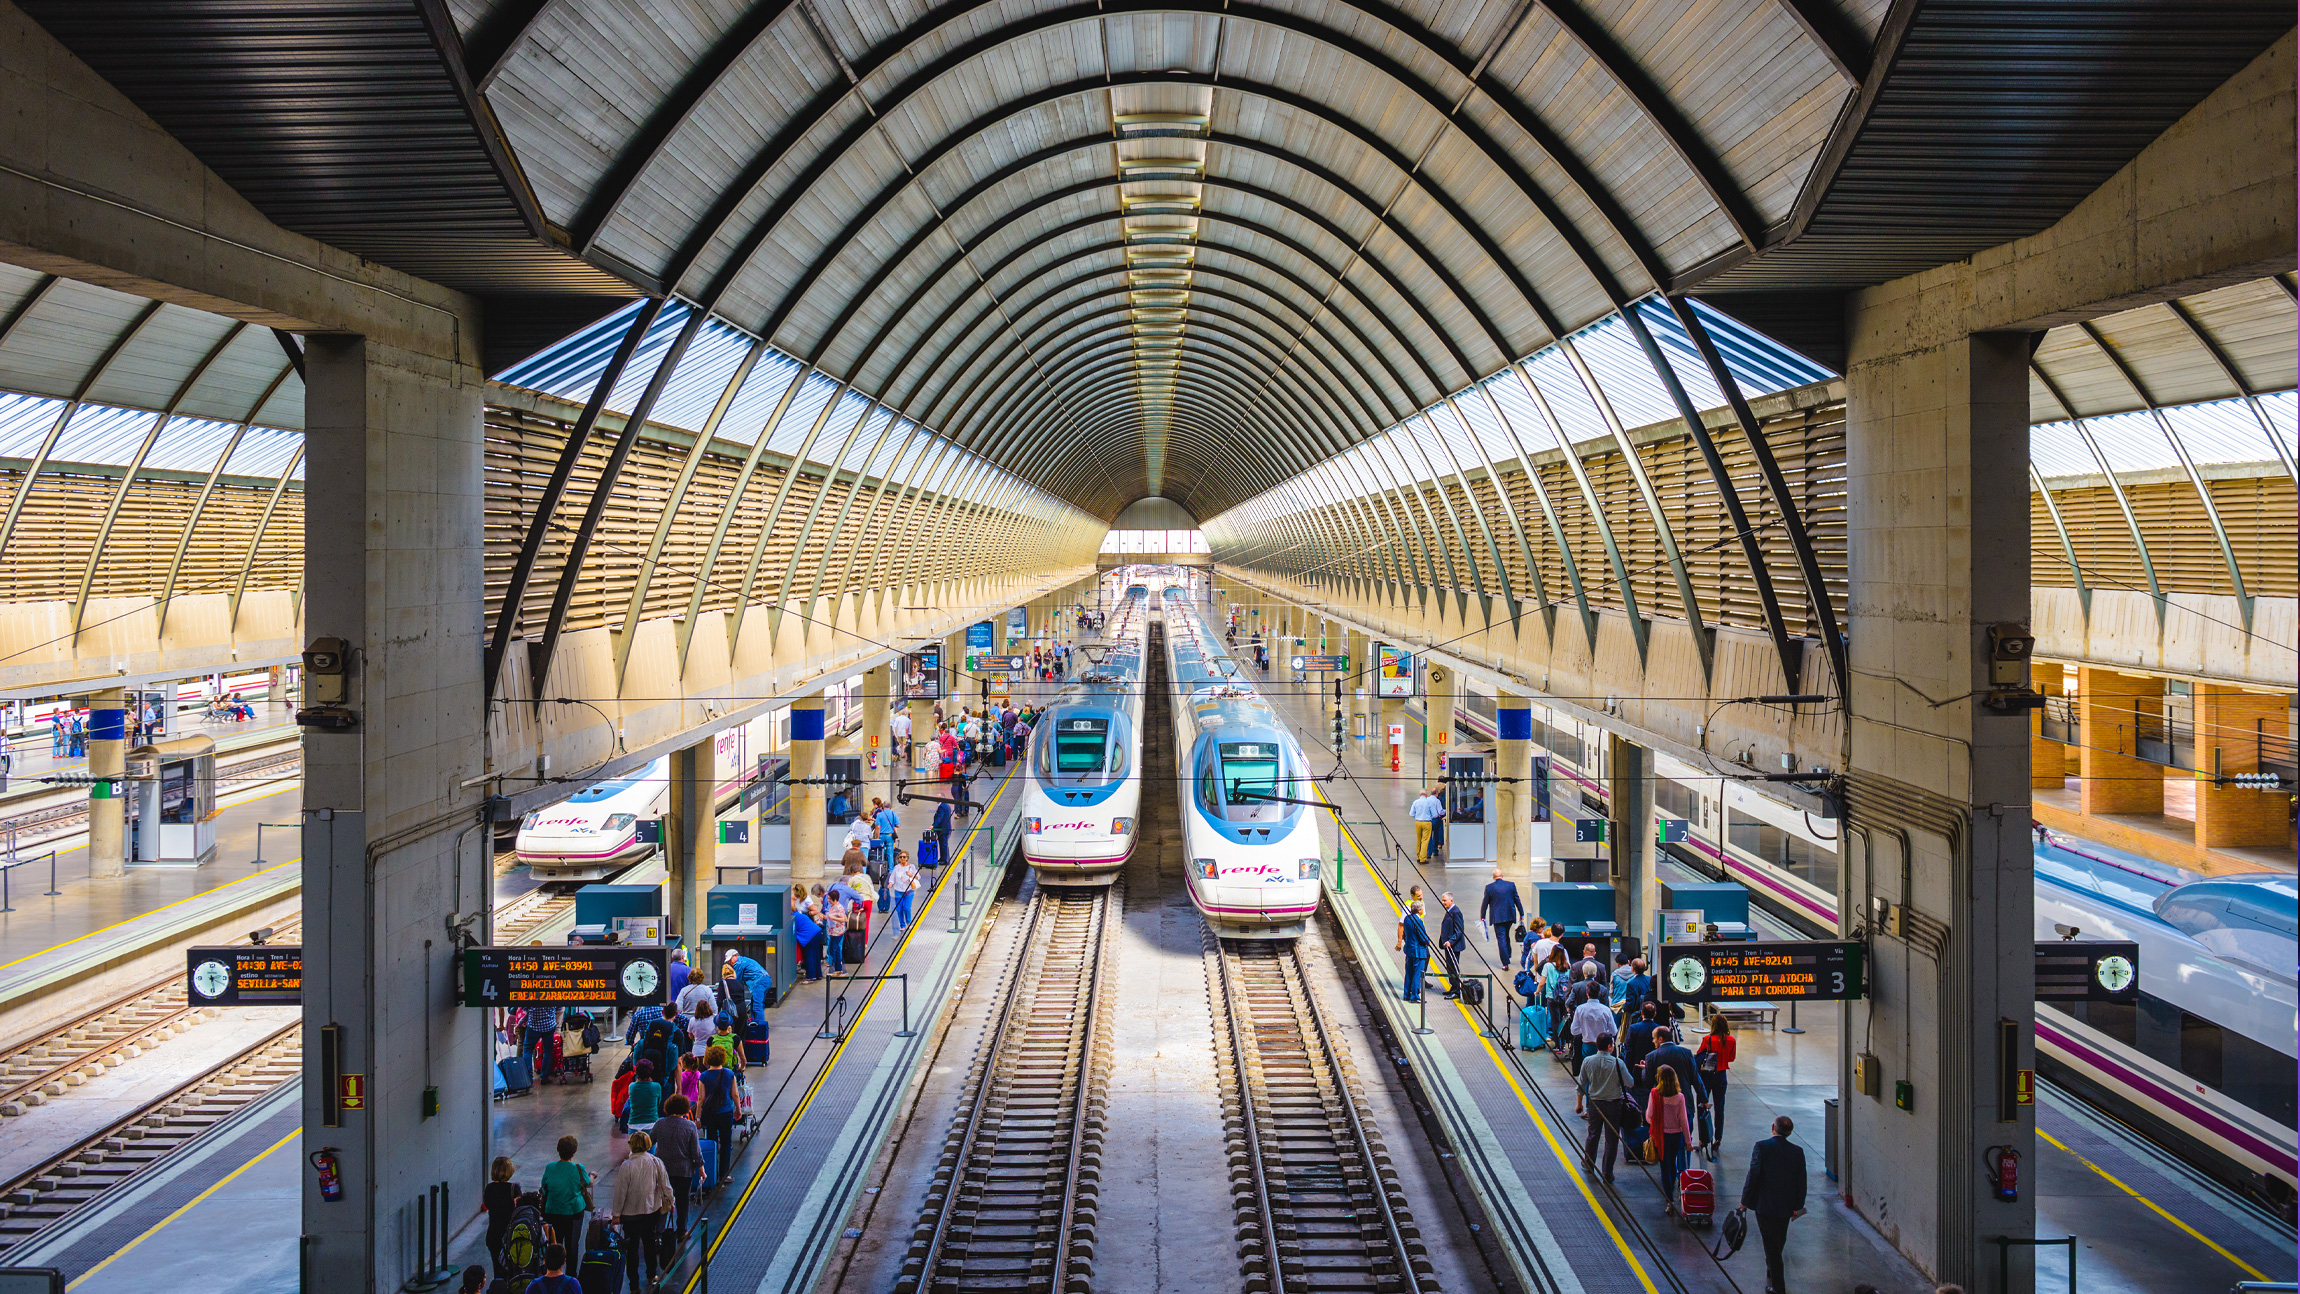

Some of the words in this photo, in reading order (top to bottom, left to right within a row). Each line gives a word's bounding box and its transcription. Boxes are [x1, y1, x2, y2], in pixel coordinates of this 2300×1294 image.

[717, 728, 735, 759] renfe
[112, 780, 122, 794] B
[538, 818, 588, 826] renfe
[1044, 821, 1094, 830] renfe
[637, 832, 643, 842] 5
[740, 832, 747, 842] 4
[1578, 831, 1584, 841] 3
[1681, 831, 1687, 841] 2
[1221, 864, 1280, 875] renfe
[236, 961, 266, 970] 14:30
[509, 962, 538, 970] 14:50
[543, 962, 593, 970] AVE-03941
[1710, 957, 1739, 966] 14:45
[1744, 956, 1793, 966] AVE-02141
[237, 979, 302, 988] SEVILLA-SAN
[1713, 974, 1747, 984] MADRID
[1752, 974, 1773, 983] PTA.
[1780, 974, 1814, 983] ATOCHA
[1832, 972, 1845, 993] 3
[482, 979, 498, 1000] 4
[521, 980, 572, 989] BARCELONA
[577, 980, 606, 988] SANTS
[1721, 986, 1745, 996] PARA
[1749, 986, 1761, 995] EN
[1765, 985, 1805, 995] CORDOBA
